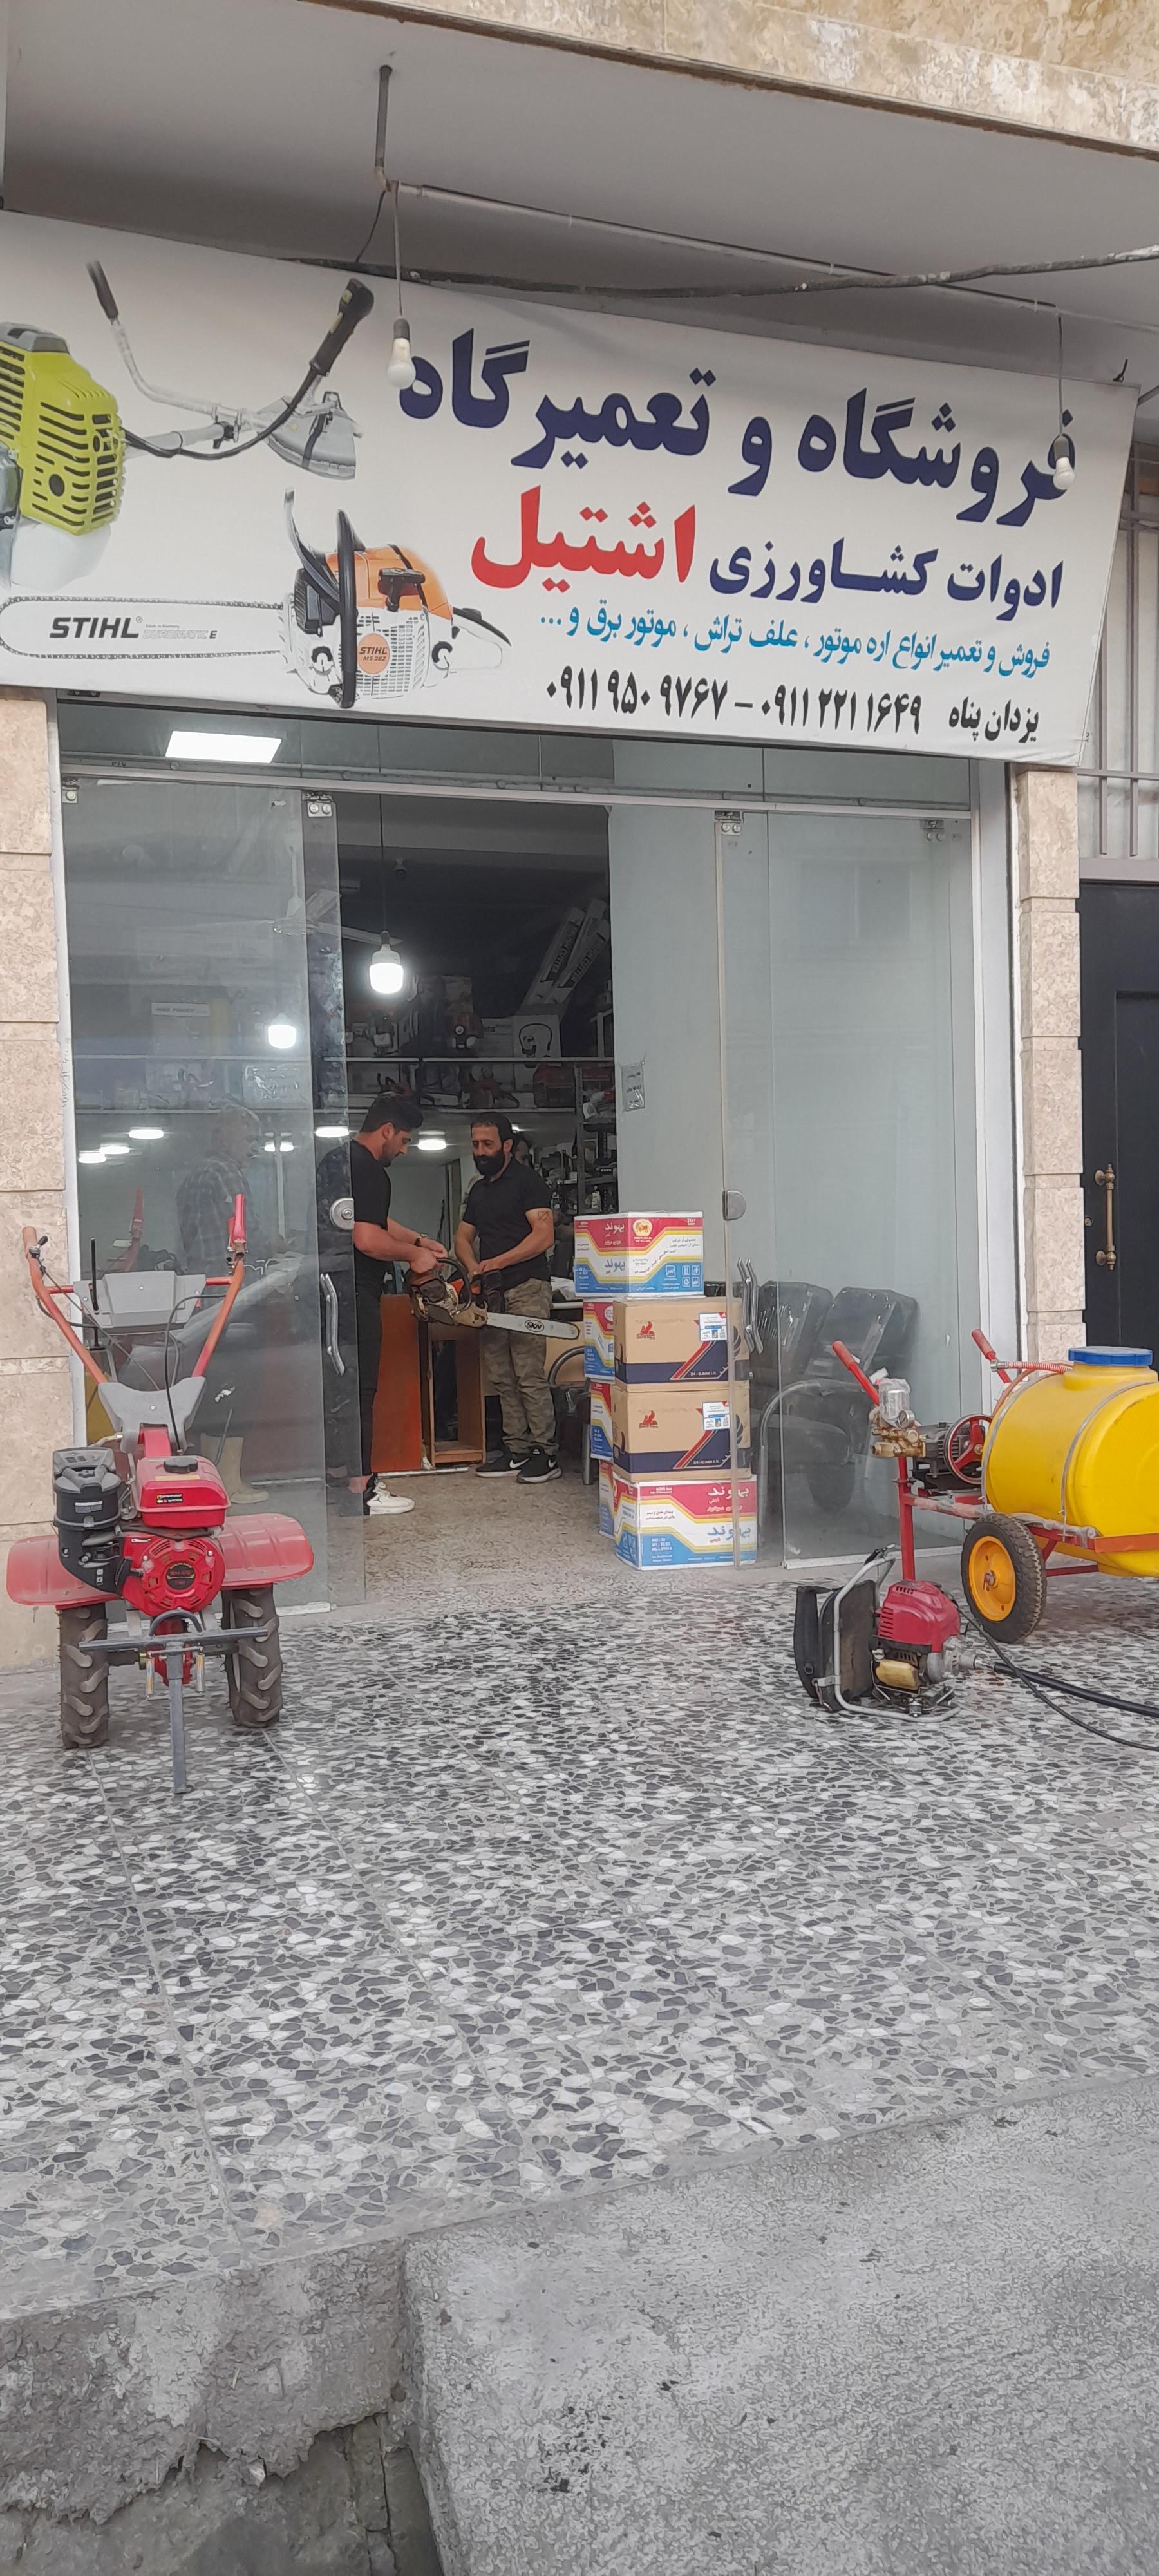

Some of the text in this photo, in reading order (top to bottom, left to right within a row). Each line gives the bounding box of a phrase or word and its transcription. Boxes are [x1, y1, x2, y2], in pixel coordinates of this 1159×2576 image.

[398, 327, 1076, 528] فروشگاه و تعمیرگاه
[471, 484, 1064, 621] ادوات کشاورزی اشتیل
[49, 616, 140, 639] STIHL
[209, 630, 218, 639] E
[566, 606, 580, 636] و
[587, 598, 622, 643] برق
[624, 609, 677, 648] موتور
[694, 614, 743, 654] تراش
[749, 618, 798, 648] علف
[359, 646, 388, 655] STIHL
[813, 628, 862, 665] موتور
[866, 629, 891, 662] اره
[892, 630, 938, 670] انواع
[933, 639, 982, 671] تعمیر
[983, 645, 995, 673] و
[997, 641, 1050, 678] فروش
[546, 665, 598, 711] ۰۹۱۱
[607, 670, 651, 714] ۹۵۰
[659, 674, 728, 721] ۹۷۶۷
[760, 684, 809, 727] ۰۹۱۱
[818, 688, 857, 731] ۲۲۱
[867, 692, 921, 734] ۱۶۴۹
[948, 696, 981, 742] پناه
[985, 698, 1039, 743] یزدان
